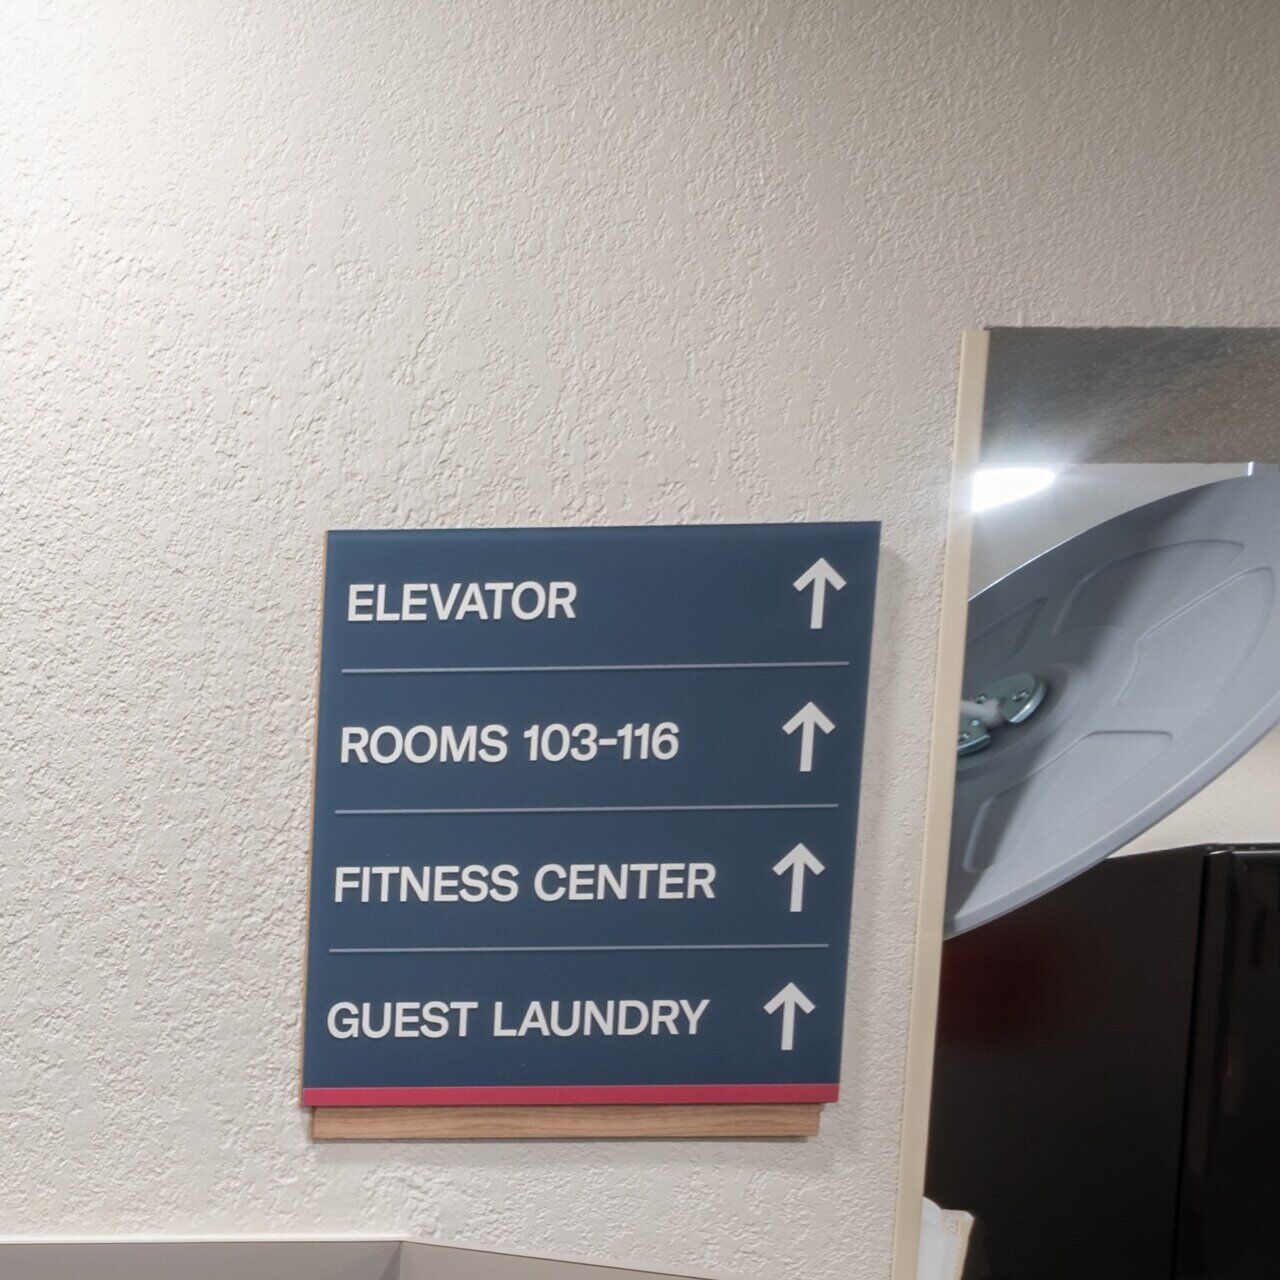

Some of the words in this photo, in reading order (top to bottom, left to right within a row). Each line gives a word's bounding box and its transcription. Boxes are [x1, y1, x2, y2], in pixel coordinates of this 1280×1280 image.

[347, 581, 578, 622] ELEVATOR
[340, 724, 508, 764] ROOMS
[523, 722, 680, 762] 103-116
[334, 865, 519, 902] FITNESS
[533, 863, 717, 901] CENTER
[326, 1002, 478, 1039] GUEST
[493, 999, 710, 1037] LAUNDRY
